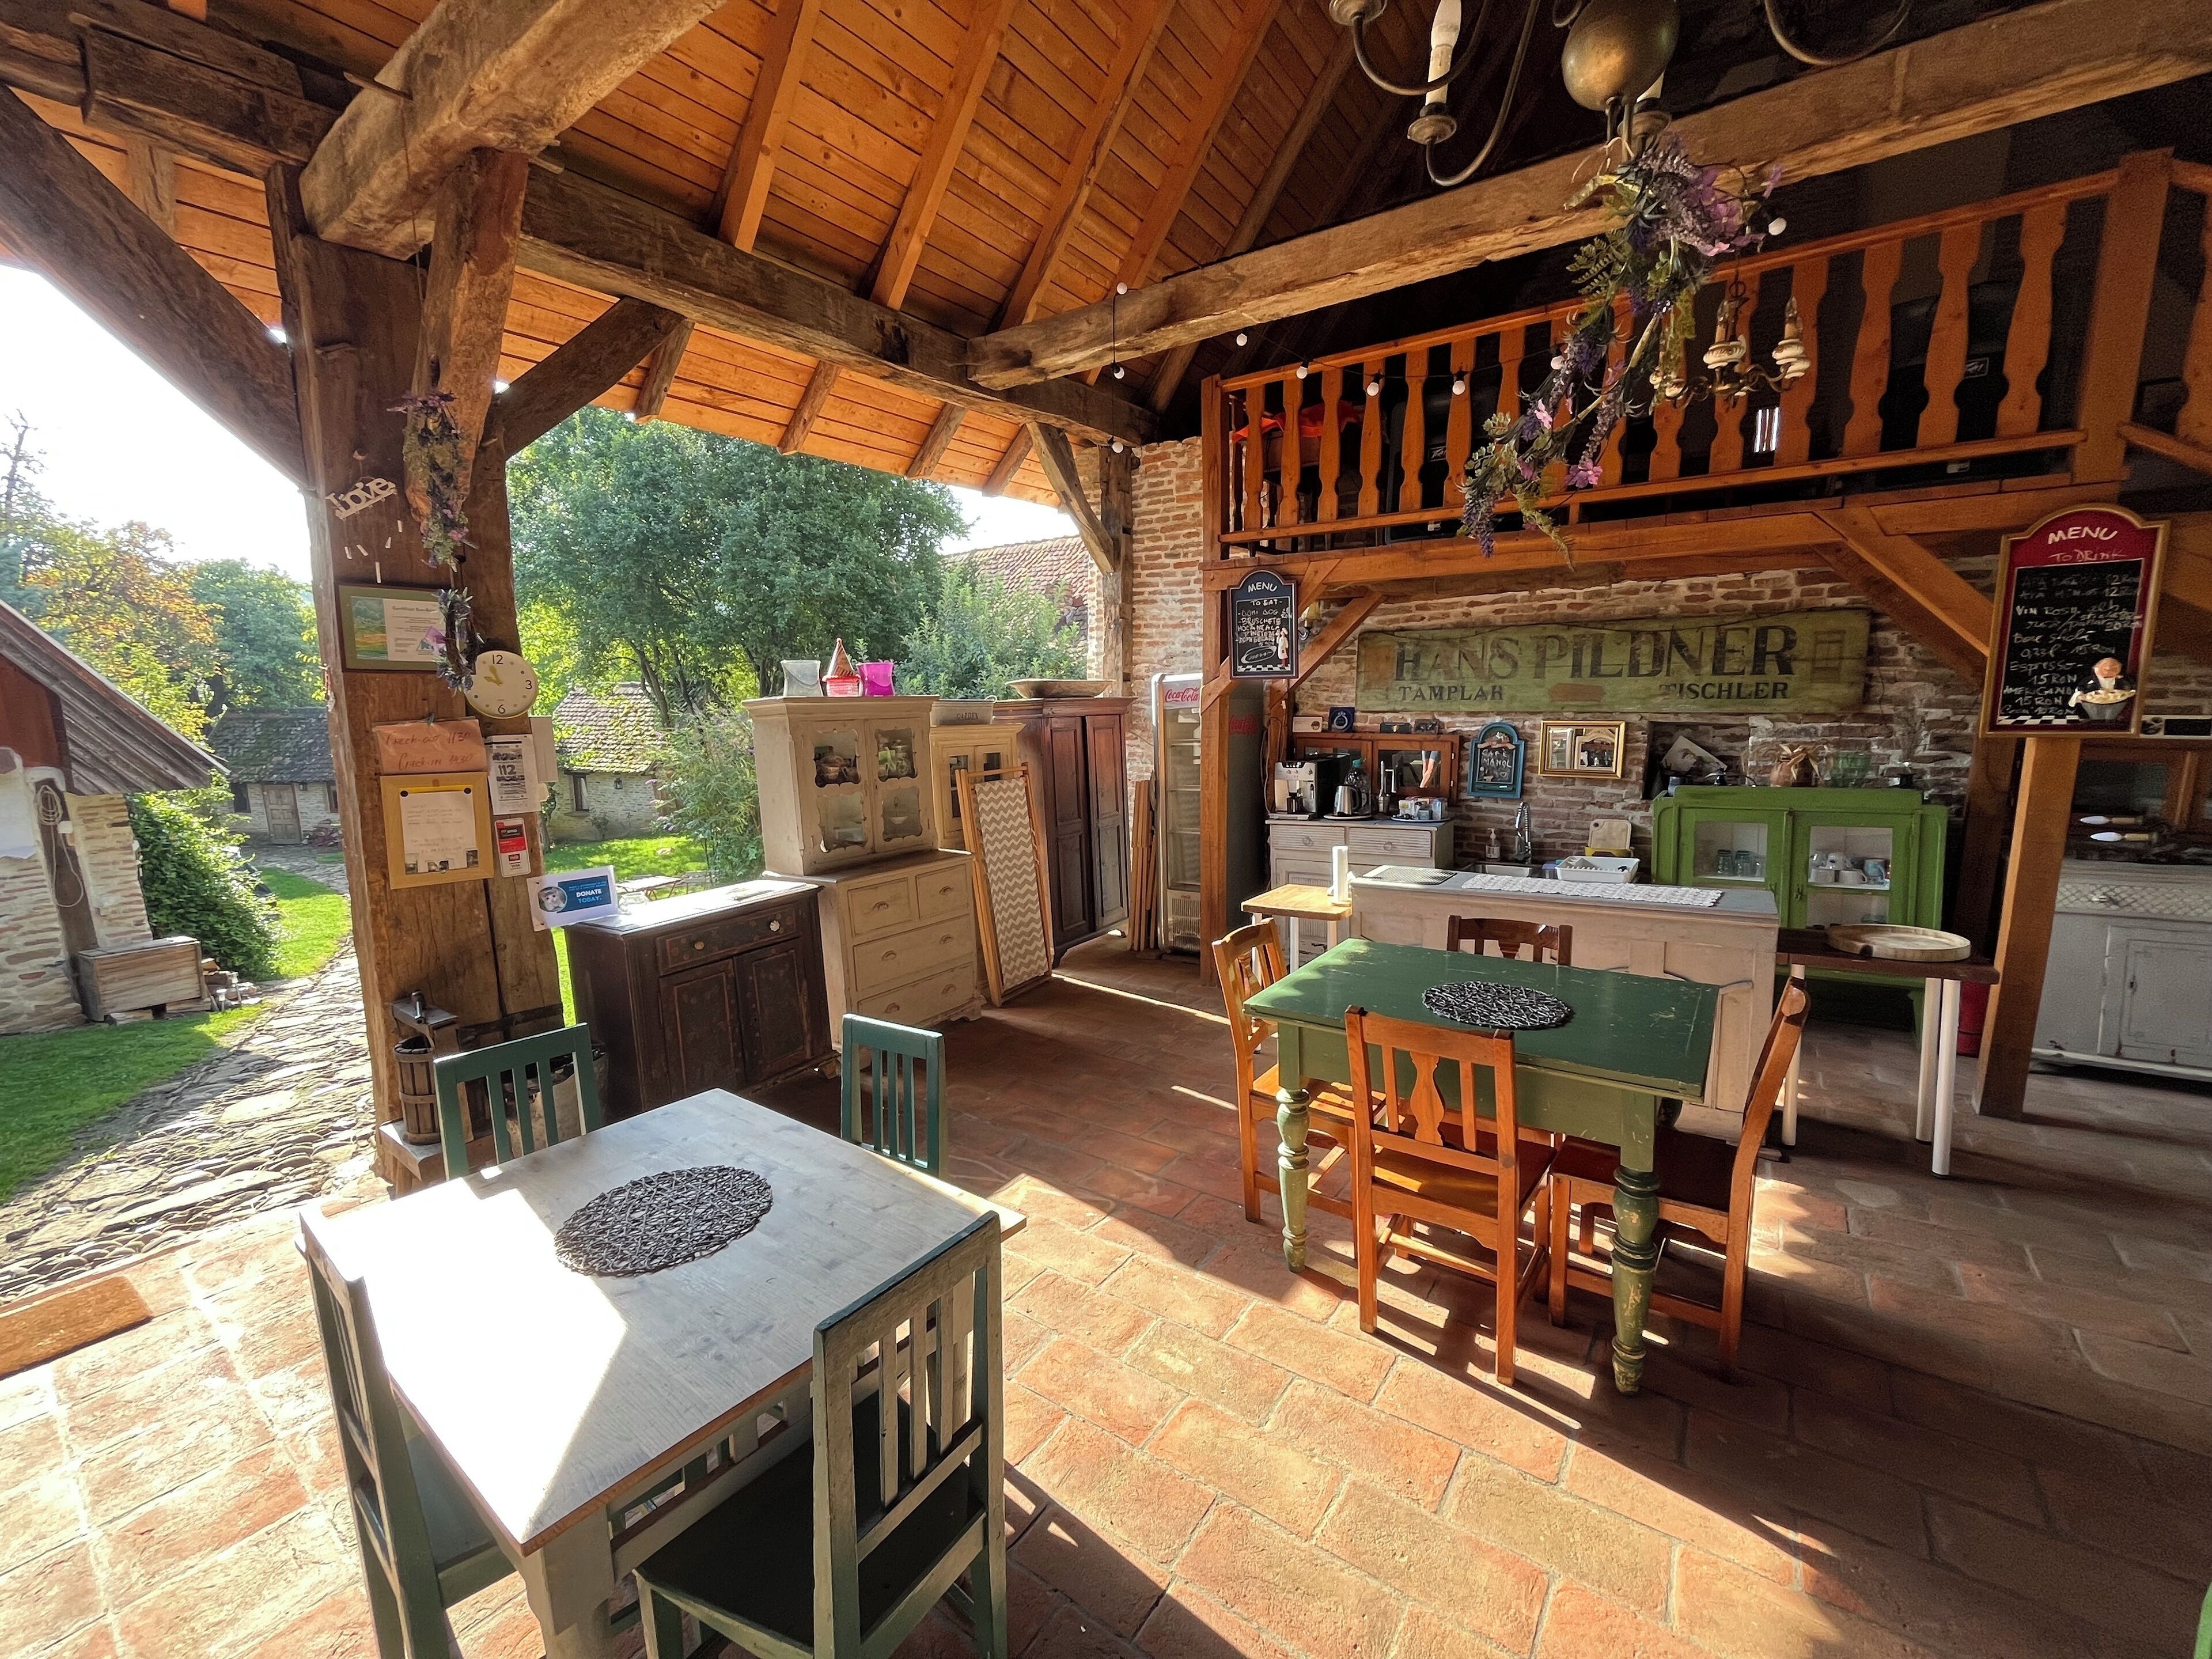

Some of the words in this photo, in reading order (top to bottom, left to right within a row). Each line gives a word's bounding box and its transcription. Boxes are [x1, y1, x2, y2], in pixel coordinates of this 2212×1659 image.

[2048, 527, 2118, 544] MENU
[1248, 582, 1278, 593] MENU
[1395, 637, 1519, 681] HANS
[1529, 625, 1798, 679] PILDNER
[492, 654, 504, 665] 12
[525, 680, 532, 690] 3
[1660, 681, 1789, 700] TISCHLER
[1165, 687, 1200, 703] Coca-Cola
[498, 704, 506, 714] 6
[498, 764, 517, 775] 112
[576, 888, 603, 898] DONATE
[578, 895, 603, 904] TODAY.
